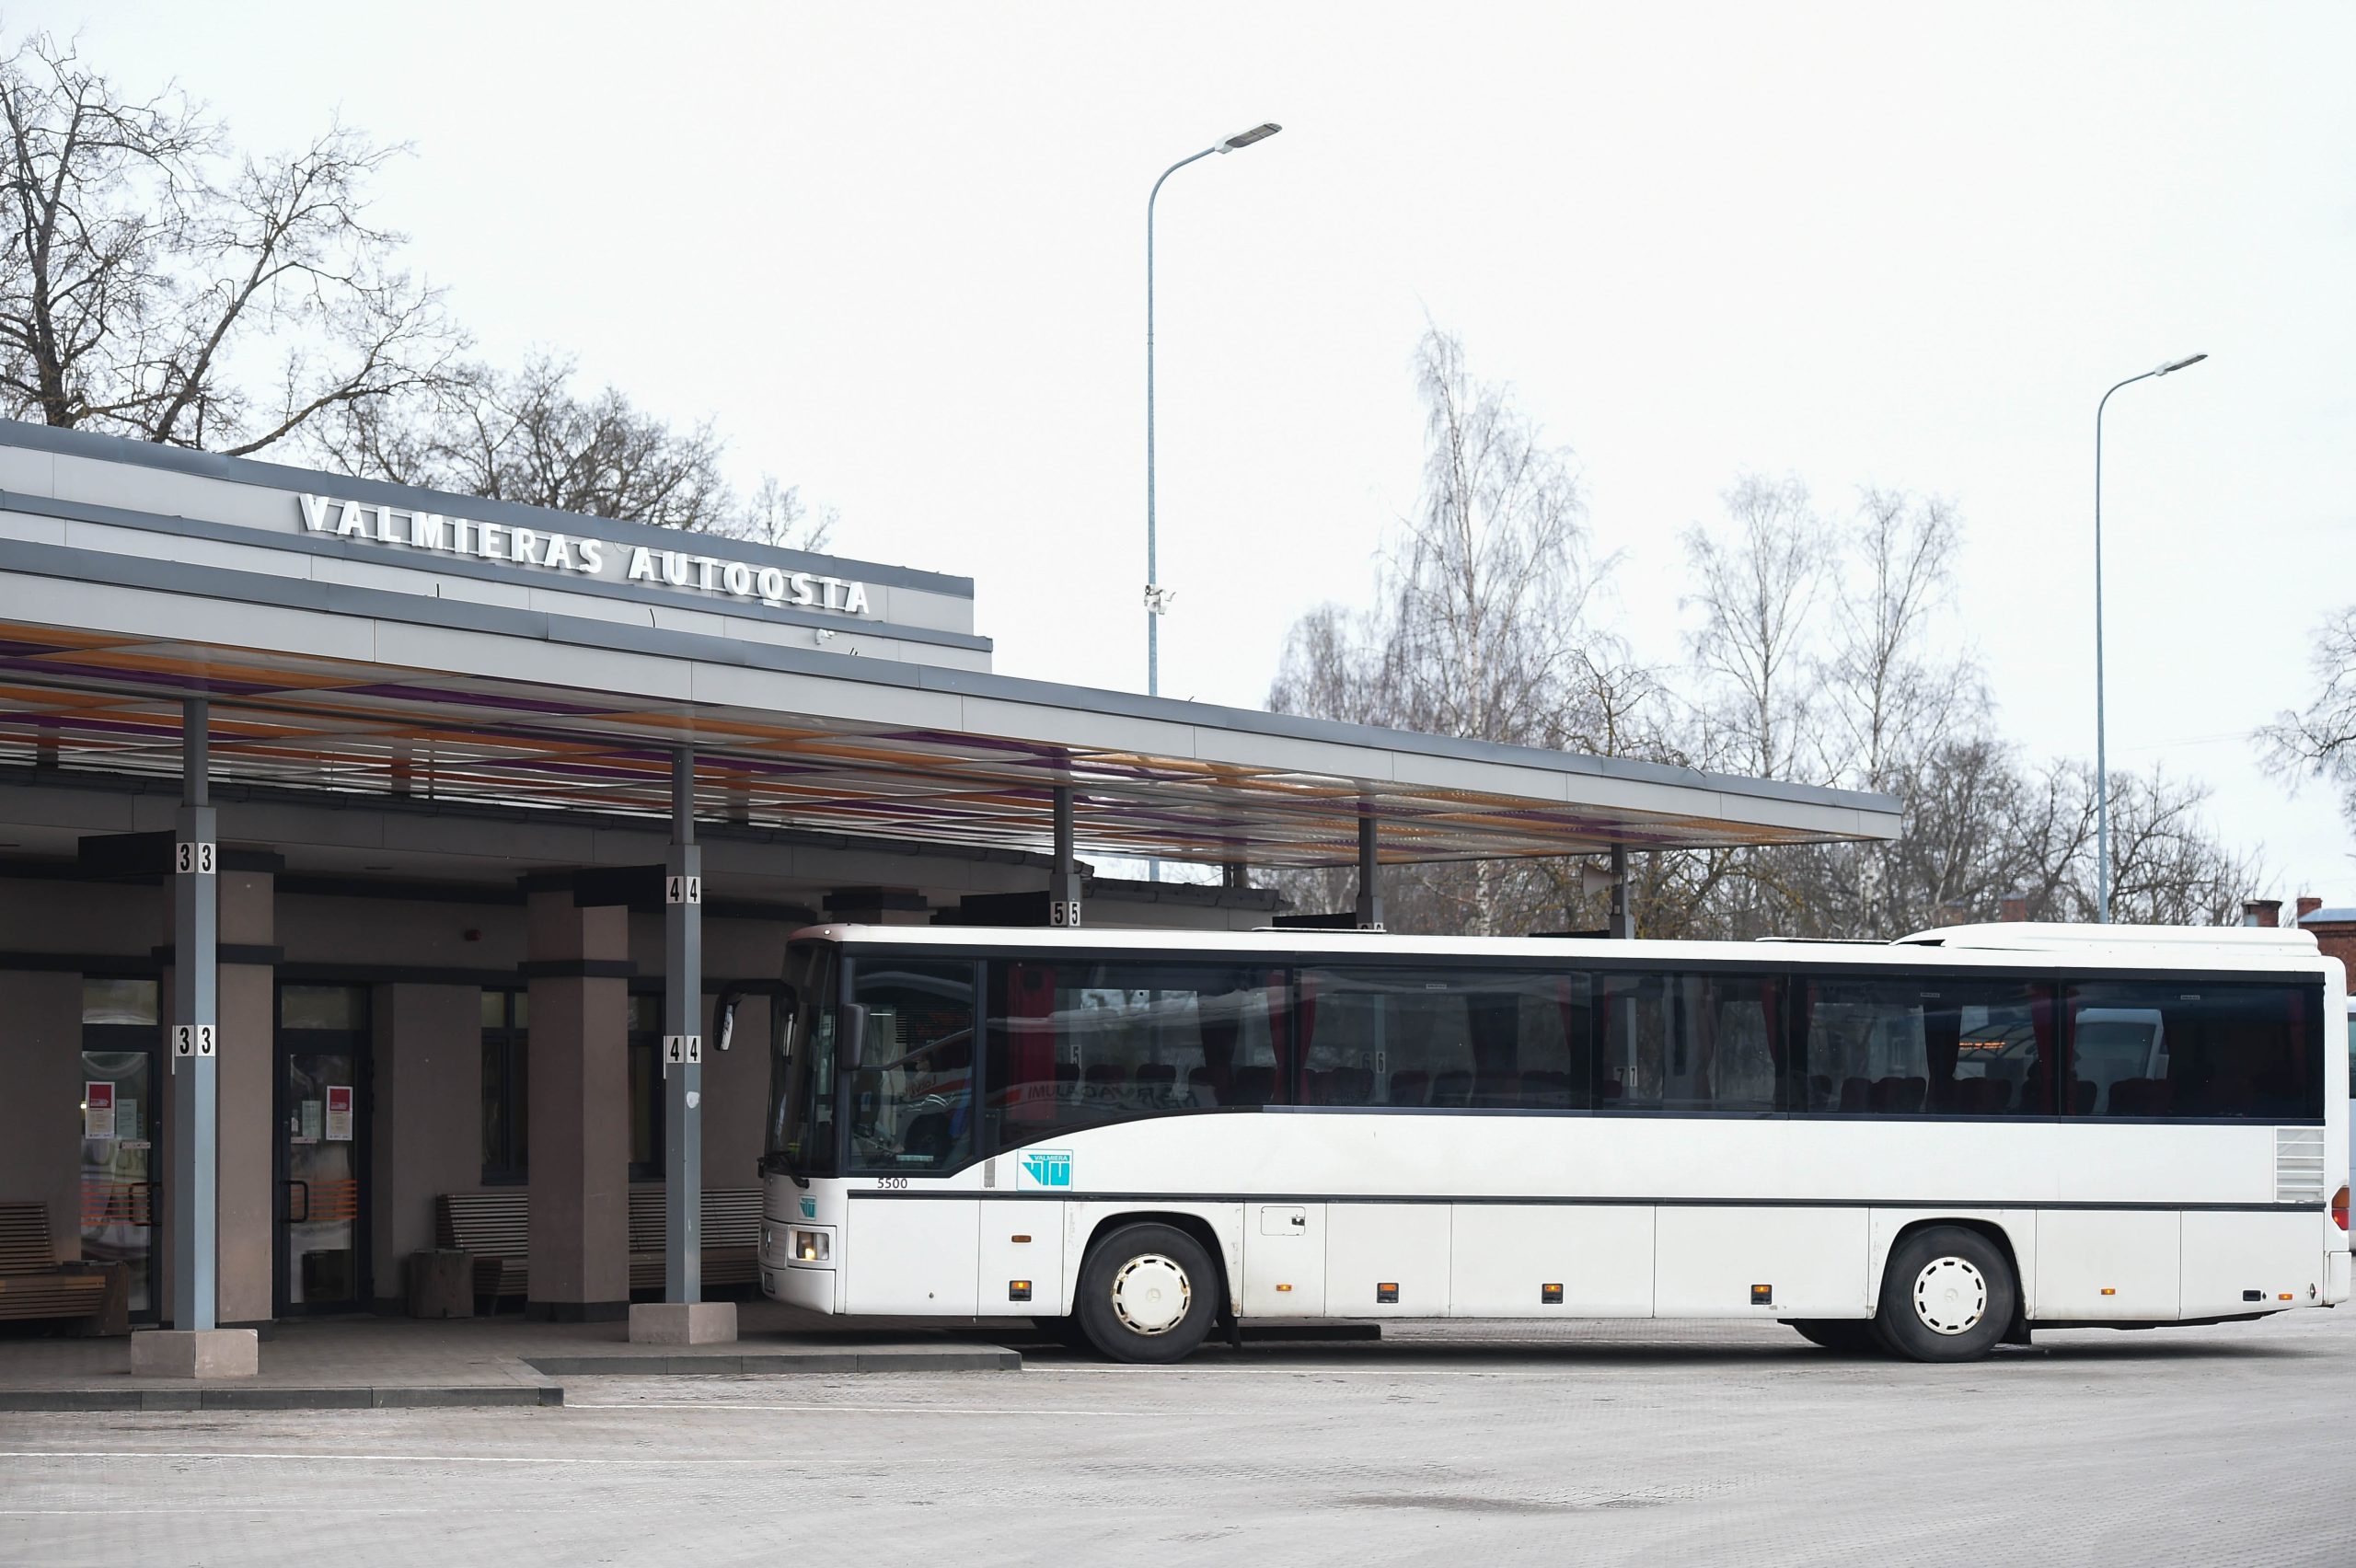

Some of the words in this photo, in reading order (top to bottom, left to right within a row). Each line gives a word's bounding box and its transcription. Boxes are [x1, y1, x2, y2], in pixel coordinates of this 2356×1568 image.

[299, 493, 603, 574] VALMIERAS
[629, 547, 870, 614] AUTOOSTA
[179, 844, 190, 871] 3
[202, 844, 212, 871] 3
[670, 877, 679, 902] 4
[689, 878, 698, 903] 4
[1054, 903, 1063, 924] 5
[1071, 903, 1078, 924] 5
[179, 1027, 190, 1055] 3
[202, 1027, 211, 1055] 3
[670, 1037, 679, 1062] 4
[689, 1037, 698, 1062] 4
[877, 1178, 908, 1189] 5500
